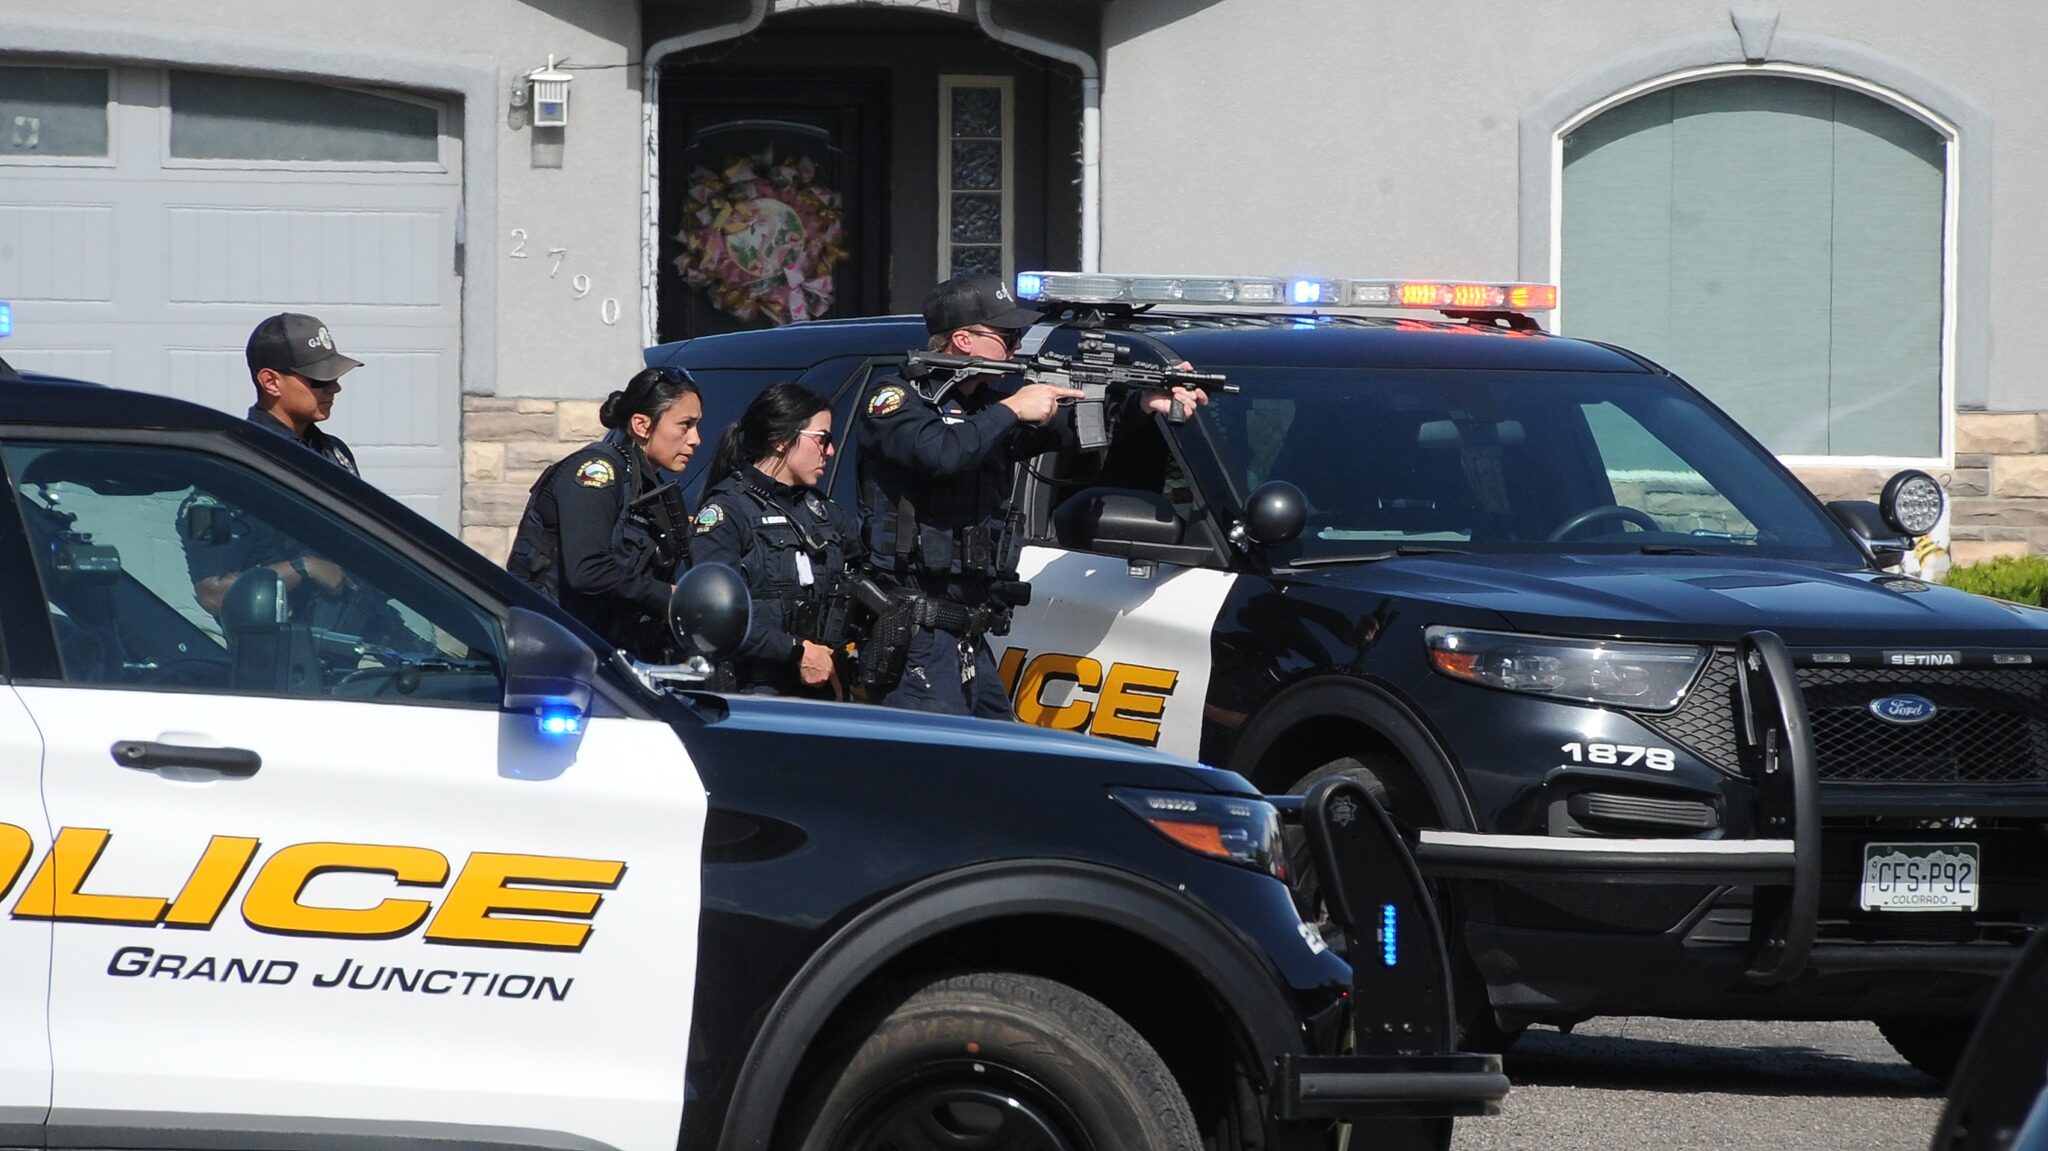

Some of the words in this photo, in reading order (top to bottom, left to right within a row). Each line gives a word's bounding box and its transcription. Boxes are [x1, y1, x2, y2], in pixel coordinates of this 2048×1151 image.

[508, 228, 621, 326] 2790
[1891, 654, 1955, 666] SETINA
[1561, 742, 1676, 772] 1878
[0, 822, 628, 953] LICE
[1891, 895, 1949, 905] COLORADO
